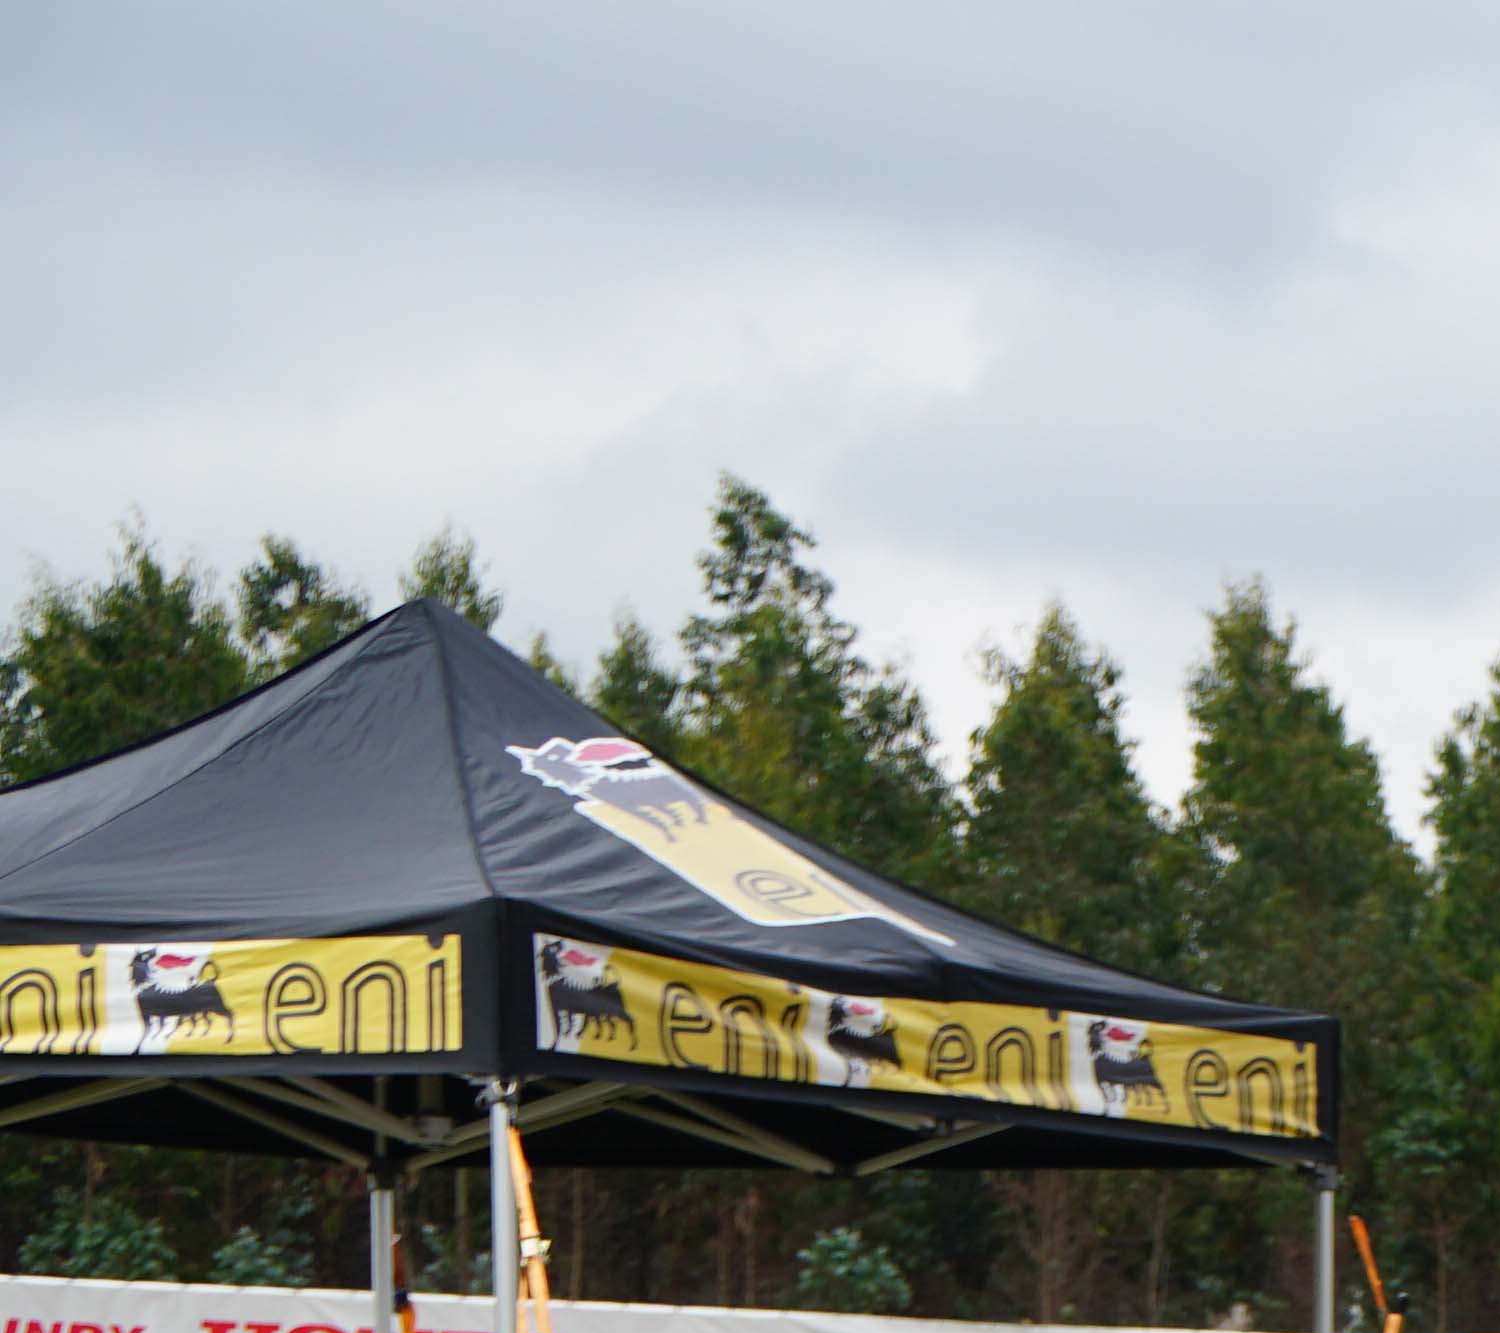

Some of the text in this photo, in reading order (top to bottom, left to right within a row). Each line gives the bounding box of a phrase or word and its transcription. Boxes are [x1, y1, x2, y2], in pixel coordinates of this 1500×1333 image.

[0, 945, 97, 1053] ni
[264, 936, 447, 1052] eni
[660, 982, 809, 1082] eni
[927, 1009, 1068, 1103] eni
[1185, 1043, 1317, 1136] eni
